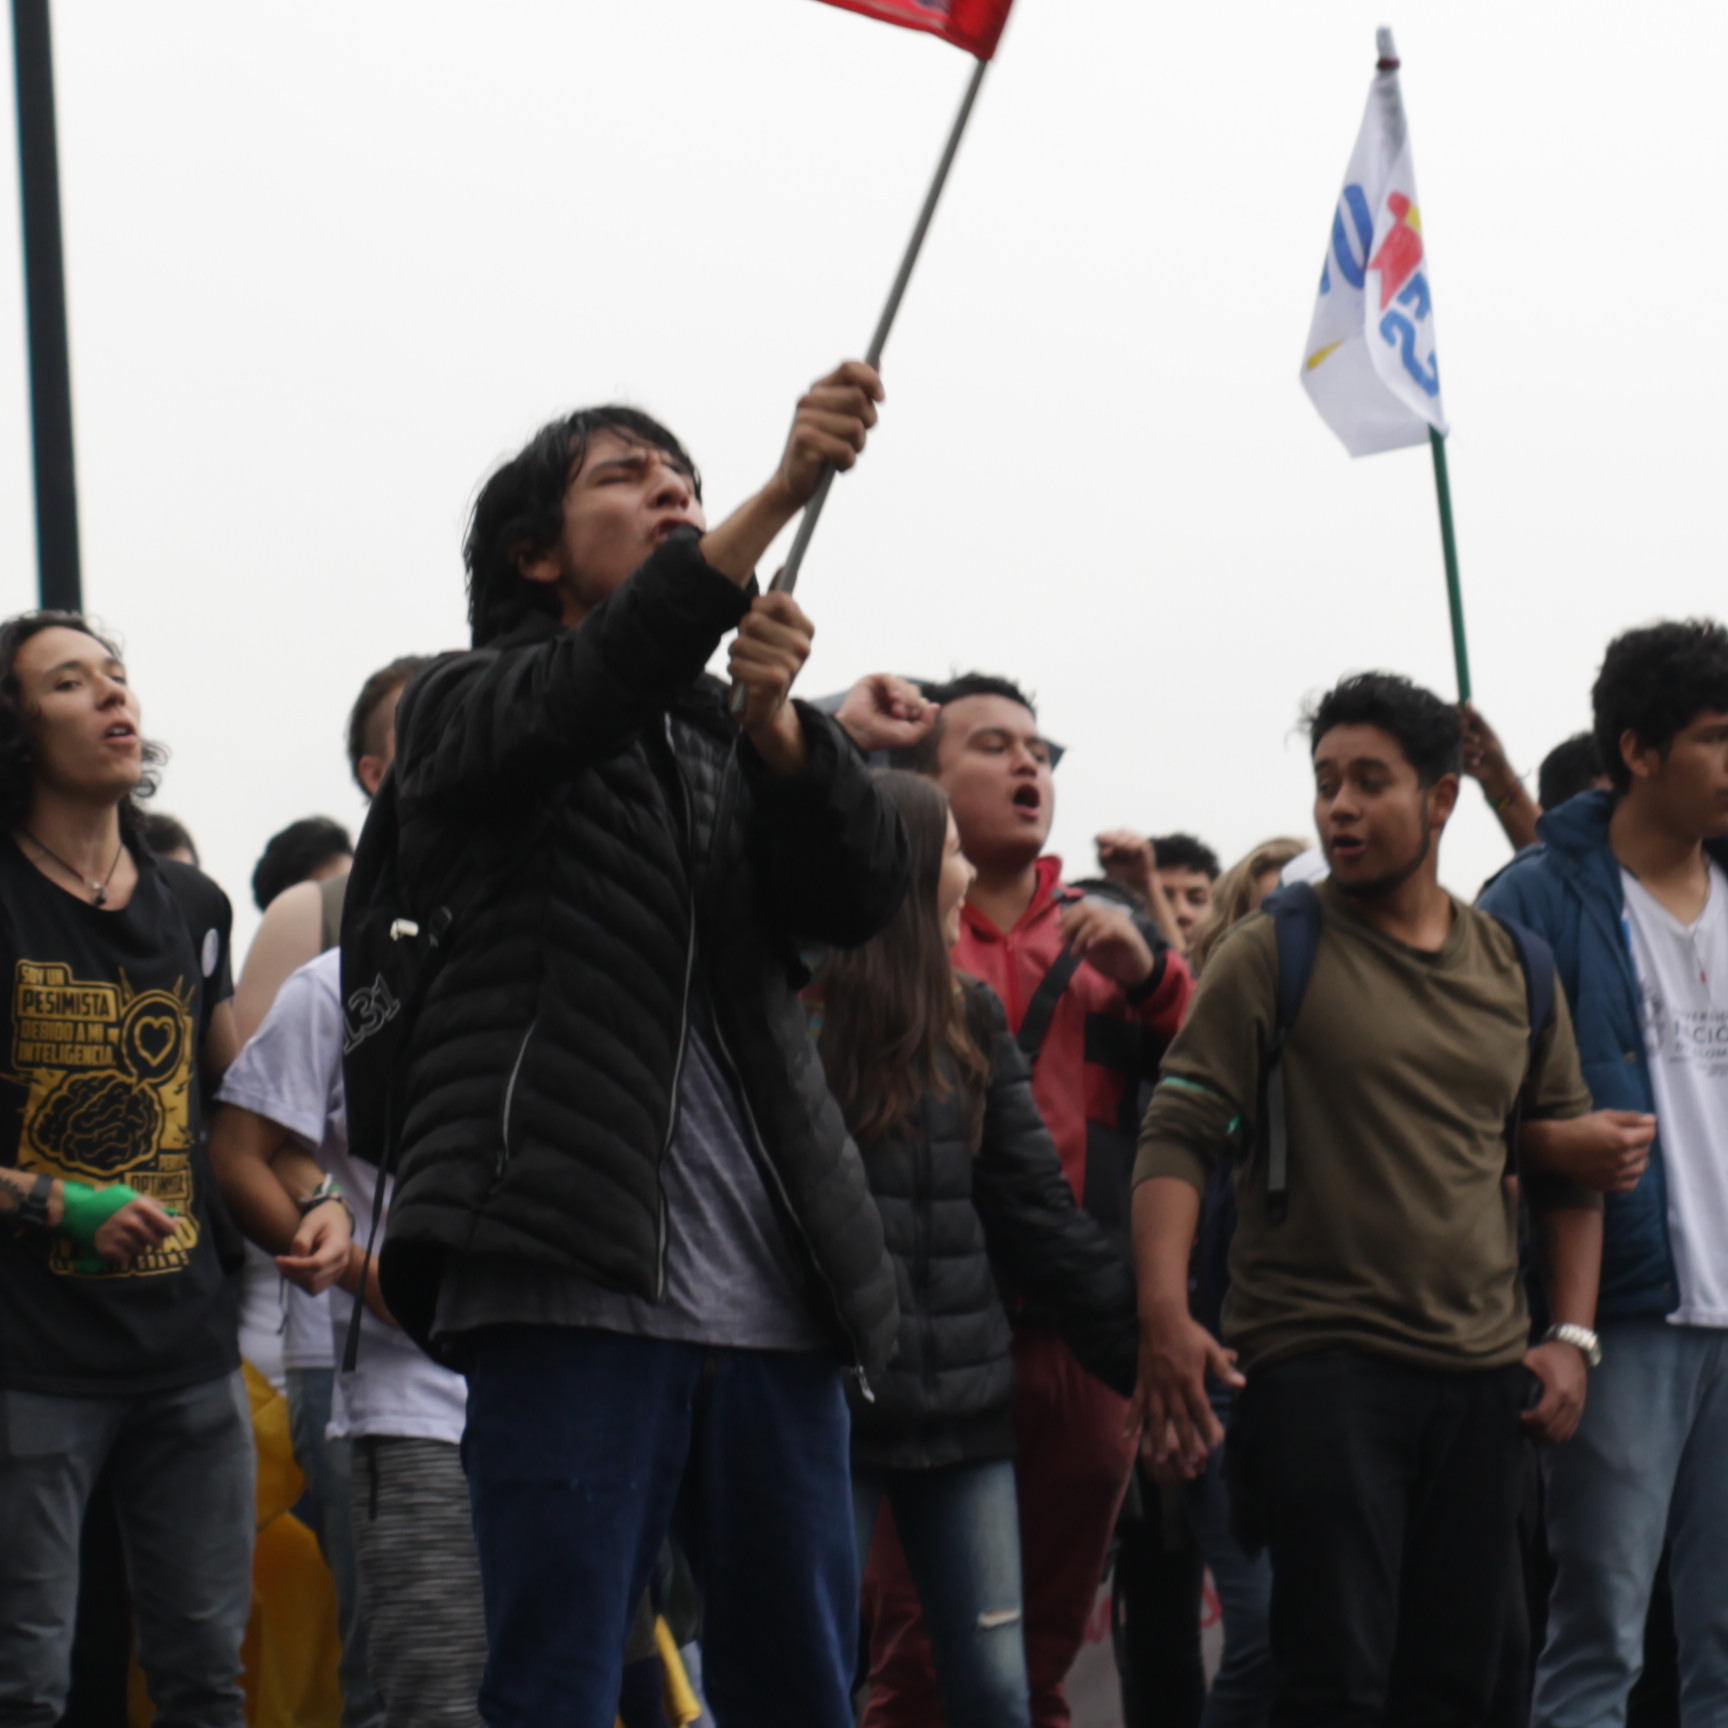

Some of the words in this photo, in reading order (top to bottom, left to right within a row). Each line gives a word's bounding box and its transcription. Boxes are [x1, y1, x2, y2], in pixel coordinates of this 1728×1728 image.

[23, 989, 110, 1017] PESIMISTA
[20, 1021, 74, 1041] DEBIDO
[76, 1023, 86, 1042] A
